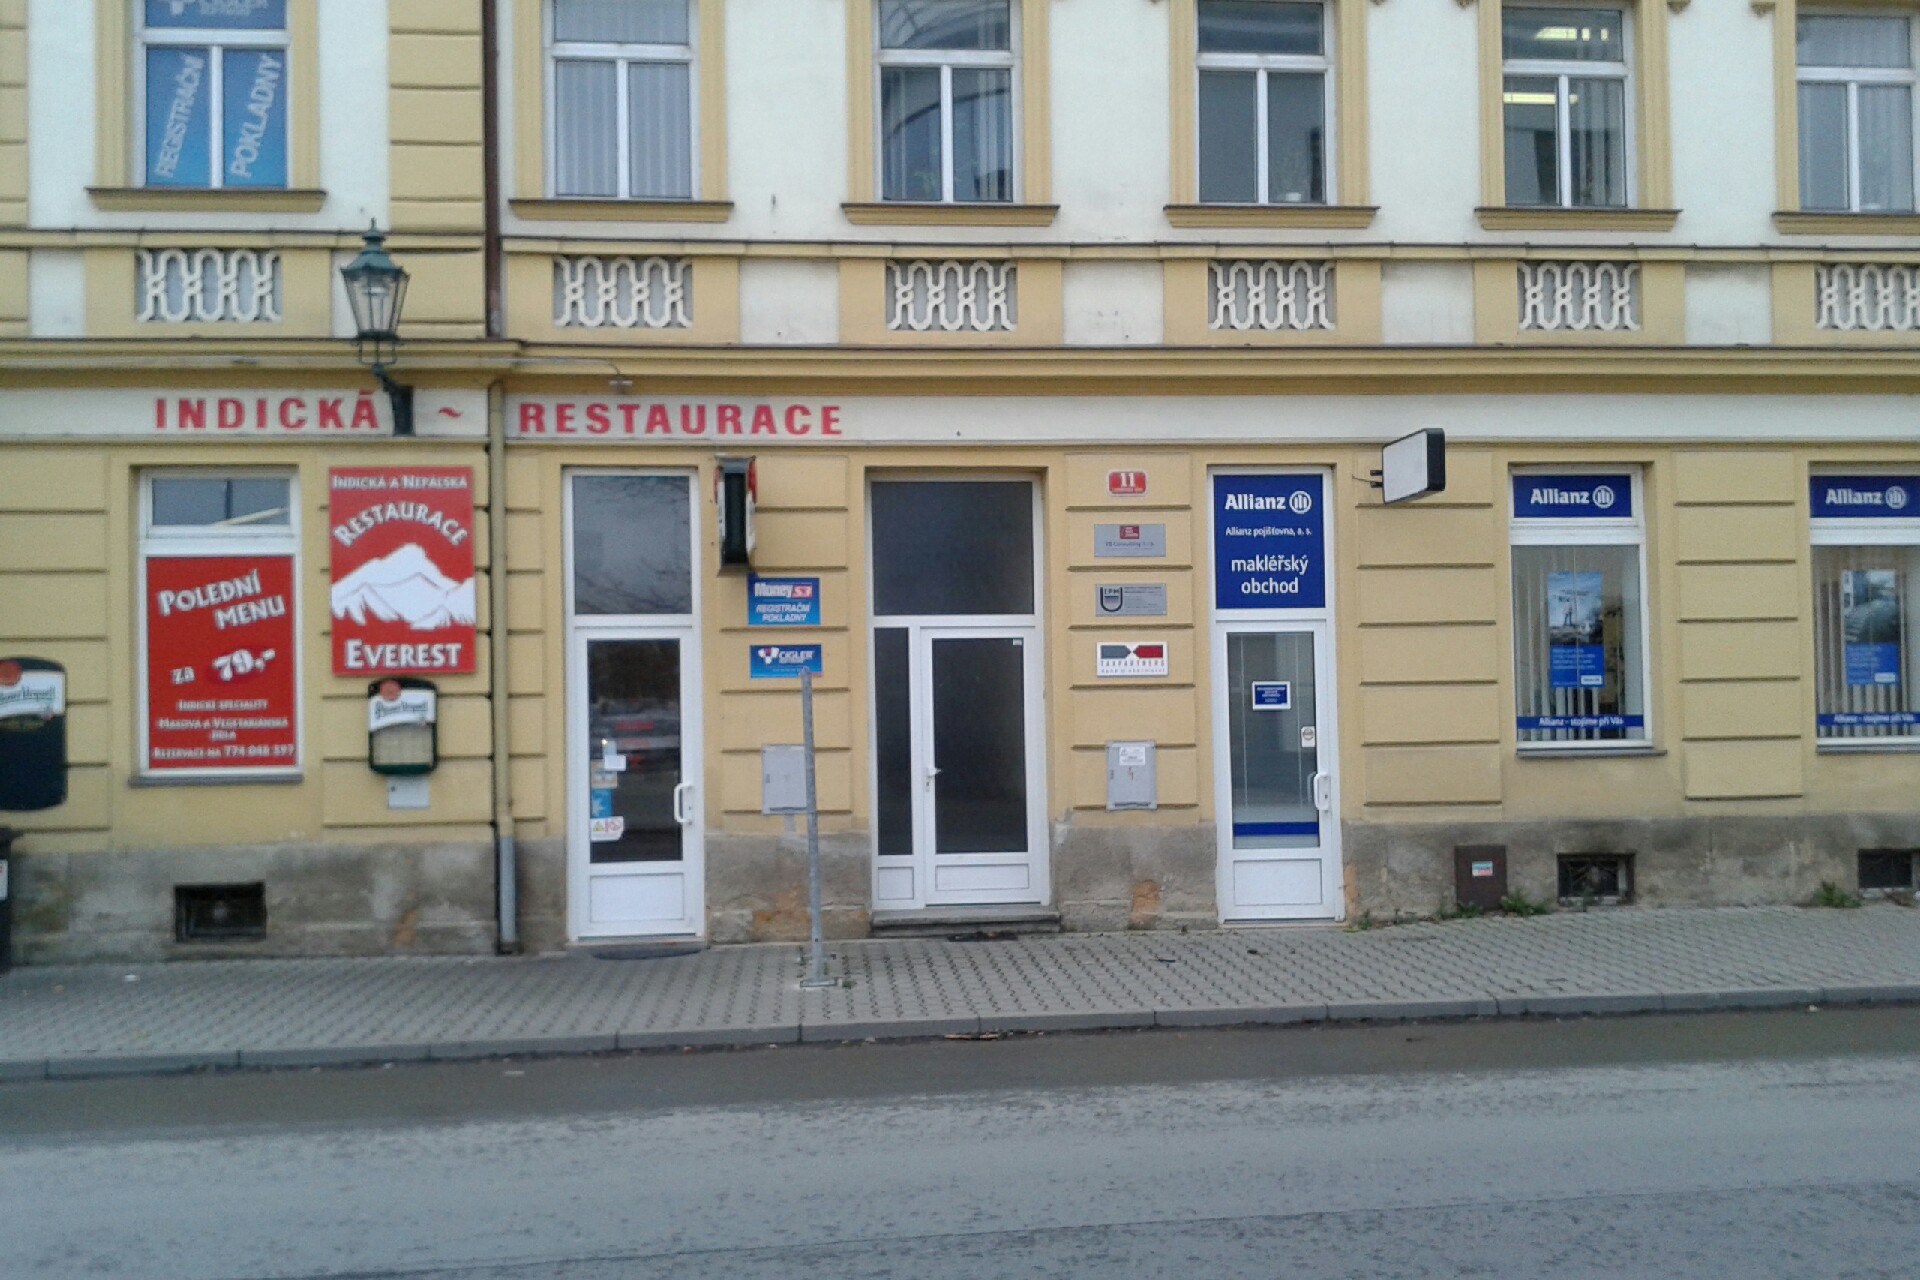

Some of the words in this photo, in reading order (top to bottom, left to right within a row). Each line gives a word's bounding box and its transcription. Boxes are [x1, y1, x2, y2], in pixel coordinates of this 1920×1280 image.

[230, 53, 281, 178] POKLADNY
[518, 403, 842, 434] RESTAURACE
[1120, 472, 1135, 488] 11
[1224, 493, 1287, 510] Allianz
[1530, 487, 1590, 504] Allianz
[1825, 487, 1883, 505] Allianz
[333, 501, 468, 547] RESTAURACE
[1225, 526, 1252, 536] Allianz
[1231, 554, 1309, 575] makléřský
[158, 568, 261, 616] POLEDNÍ
[1241, 577, 1299, 594] obchod
[214, 594, 286, 630] MENU
[762, 613, 807, 622] POKLADNY
[345, 639, 462, 669] EVEREST
[171, 666, 195, 684] za
